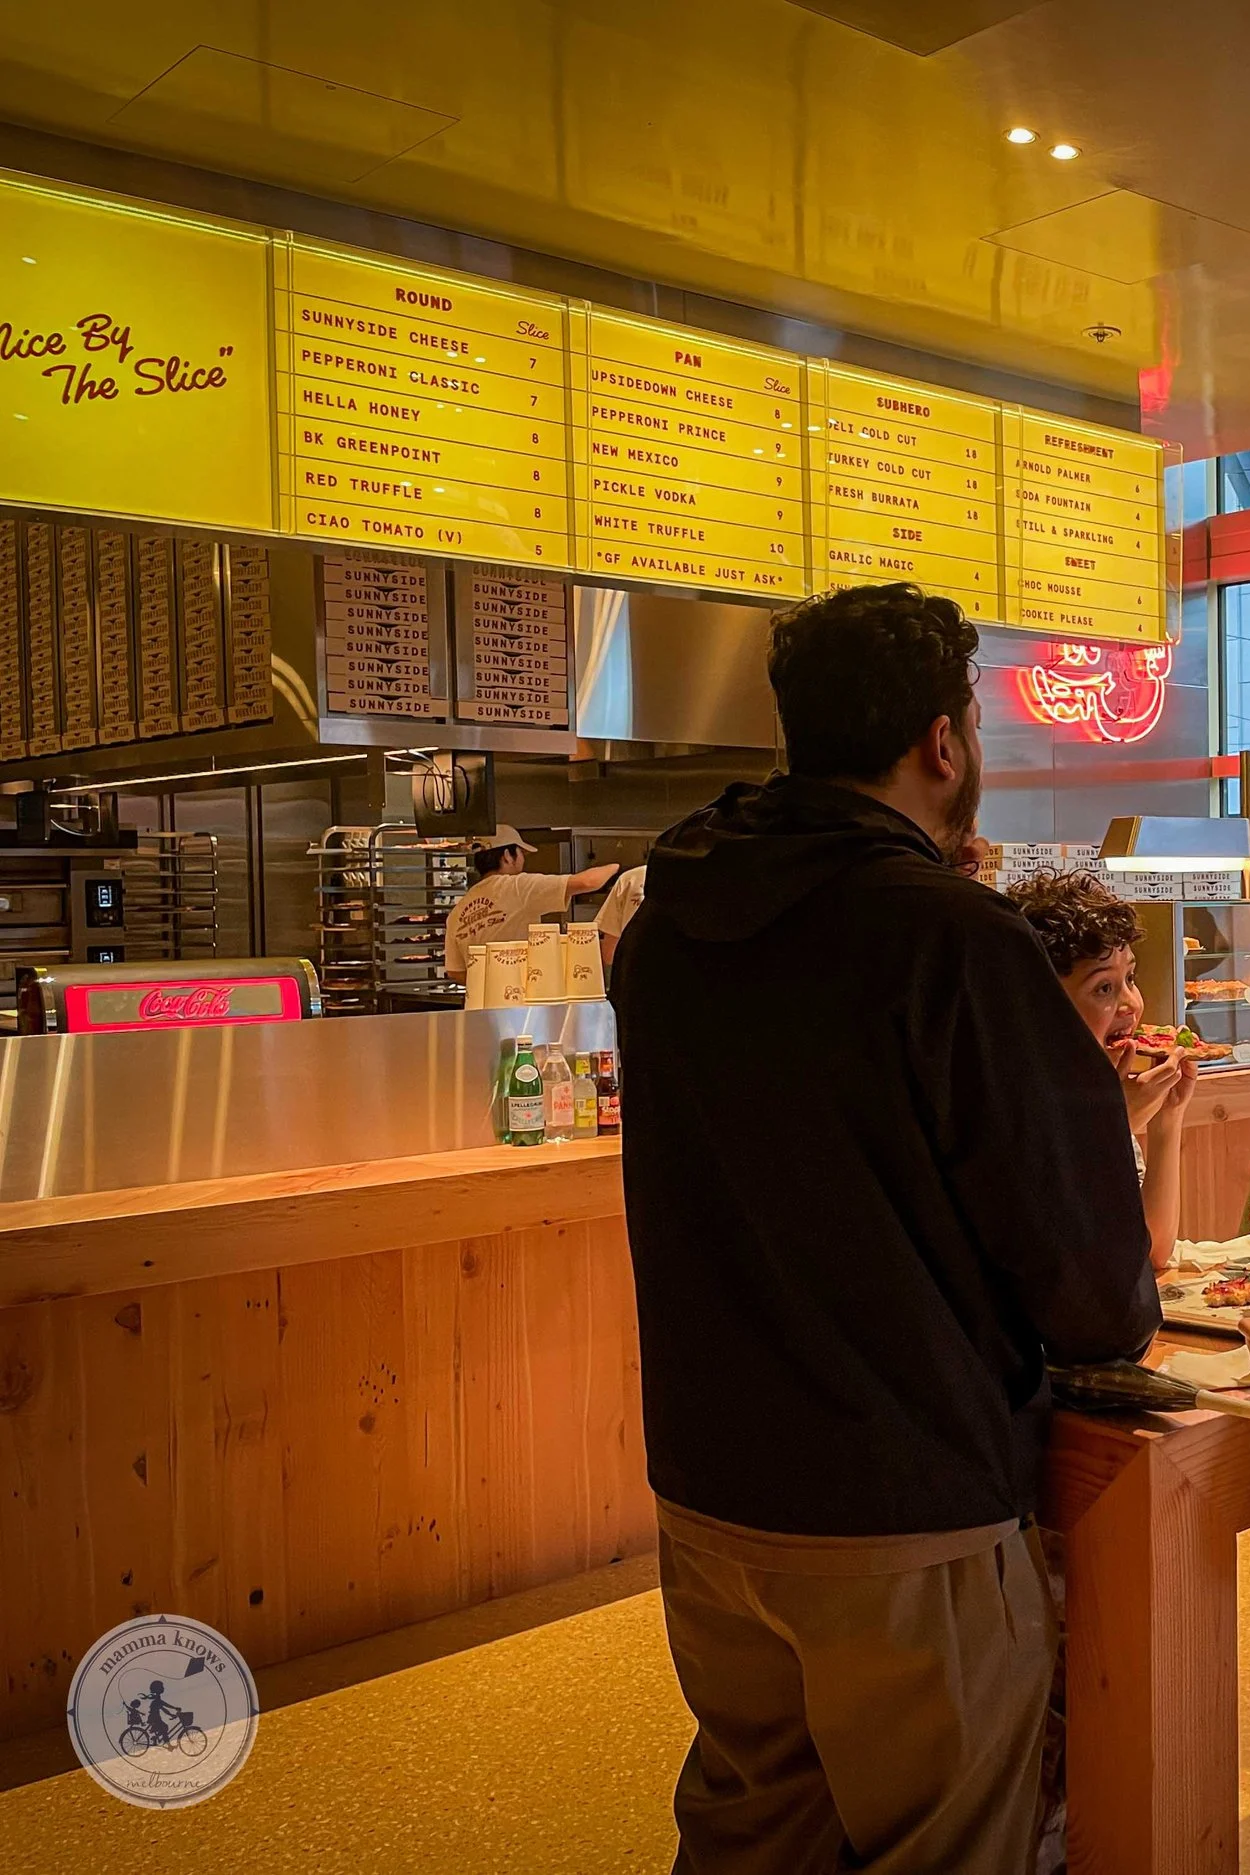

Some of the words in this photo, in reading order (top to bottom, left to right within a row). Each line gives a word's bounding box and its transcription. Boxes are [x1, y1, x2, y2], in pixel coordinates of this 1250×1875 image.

[395, 288, 452, 312] ROUND
[77, 313, 134, 363] By
[302, 309, 398, 340] SUNNYSIDE
[410, 332, 469, 354] CHEESE
[516, 320, 550, 340] Slice
[529, 358, 536, 369] 7
[675, 351, 702, 368] PAN
[302, 350, 397, 379] PEPPERONI
[409, 371, 480, 395] CLASSIC
[42, 363, 119, 404] The
[592, 370, 676, 397] UPSIDEDOWN
[686, 390, 733, 408] CHEESE
[764, 378, 791, 394] Slice
[303, 390, 357, 411] HELLA
[369, 402, 420, 422] HONEY
[530, 396, 538, 407] 7
[877, 397, 931, 417] SUBHERO
[775, 409, 780, 419] 8
[592, 406, 668, 430] PEPPERONI
[679, 424, 726, 442] PRINCE
[532, 433, 539, 444] 8
[862, 427, 889, 440] COLD
[897, 434, 917, 446] CUT
[304, 431, 324, 445] BK
[337, 437, 441, 463] GREENPOINT
[592, 443, 618, 457] NEW
[628, 449, 679, 467] MEXICO
[776, 443, 781, 452] 9
[966, 449, 977, 459] 18
[1045, 435, 1114, 459] REFRESHMENT
[829, 452, 869, 468] TURKEY
[878, 462, 904, 475] COLD
[912, 468, 931, 480] CUT
[1016, 459, 1051, 475] ARNOLD
[1058, 468, 1091, 483] PALMER
[533, 471, 540, 481] 8
[776, 477, 782, 487] 9
[966, 479, 977, 489] 18
[306, 472, 337, 487] RED
[350, 479, 423, 500] TRUFFLE
[594, 479, 645, 497] PICKLE
[655, 488, 696, 505] VODKA
[1135, 485, 1140, 493] 6
[829, 484, 863, 500] FRESH
[872, 492, 919, 510] BURRATA
[1016, 489, 1039, 502] SODA
[1046, 495, 1091, 512] FOUNTAIN
[534, 508, 541, 519] 8
[777, 511, 783, 520] 9
[967, 510, 978, 520] 18
[1136, 513, 1140, 521] 4
[307, 513, 350, 529] CIAO
[362, 520, 424, 538] TOMATO
[438, 530, 463, 544] (V)
[594, 516, 638, 531] WHITE
[648, 523, 705, 541] TRUFFLE
[893, 527, 922, 541] SIDE
[1052, 526, 1057, 535] &
[1063, 528, 1114, 545] SPARKLING
[535, 545, 542, 556] 5
[770, 543, 784, 553] 10
[1136, 541, 1140, 549] 4
[632, 556, 705, 576] AVAILABLE
[715, 567, 744, 581] JUST
[829, 550, 872, 565] GARLIC
[880, 557, 914, 571] MAGIC
[345, 570, 425, 587] SUNNYSIDE
[974, 572, 979, 581] 4
[346, 589, 426, 605] SUNNYSIDE
[474, 584, 547, 602] SUNNYSIDE
[1048, 584, 1081, 597] MOUSSE
[1138, 596, 1142, 605] 6
[348, 608, 428, 623] SUNNYSIDE
[474, 601, 548, 619] SUNNYSIDE
[1021, 609, 1054, 622] COOKIE
[1061, 613, 1093, 627] PLEASE
[348, 625, 428, 641] SUNNYSIDE
[475, 619, 548, 635] SUNNYSIDE
[1138, 624, 1143, 632] 4
[347, 642, 427, 657] SUNNYSIDE
[475, 637, 548, 652] SUNNYSIDE
[349, 662, 428, 676] SUNNYSIDE
[476, 654, 549, 670] SUNNYSIDE
[348, 680, 428, 694] SUNNYSIDE
[476, 672, 549, 687] SUNNYSIDE
[476, 690, 549, 704] SUNNYSIDE
[350, 699, 430, 713] SUNNYSIDE
[478, 707, 550, 720] SUNNYSIDE
